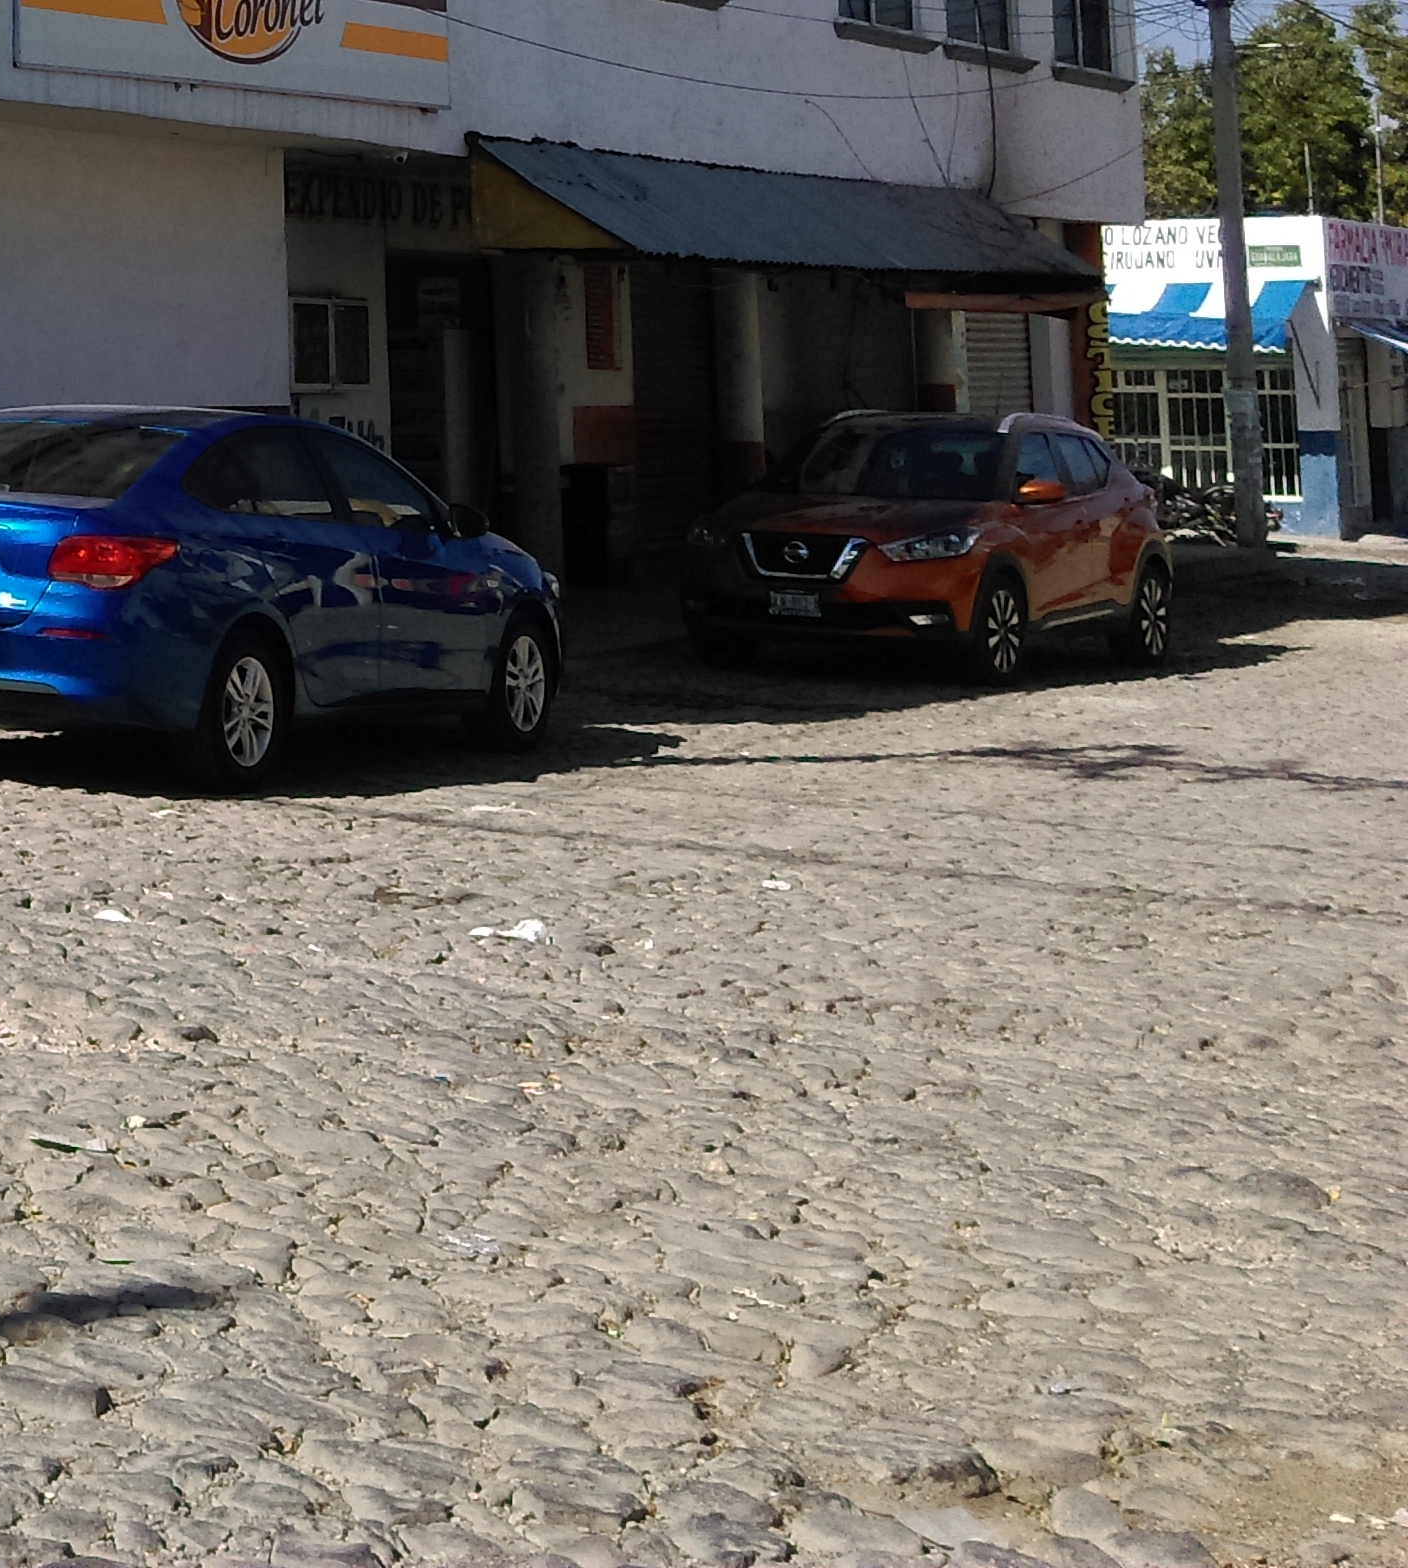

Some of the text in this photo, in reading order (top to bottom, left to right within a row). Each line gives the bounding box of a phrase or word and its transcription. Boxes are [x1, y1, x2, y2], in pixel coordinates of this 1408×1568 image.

[285, 173, 472, 226] EXPENDIO DE P
[1122, 225, 1188, 246] LOZANO
